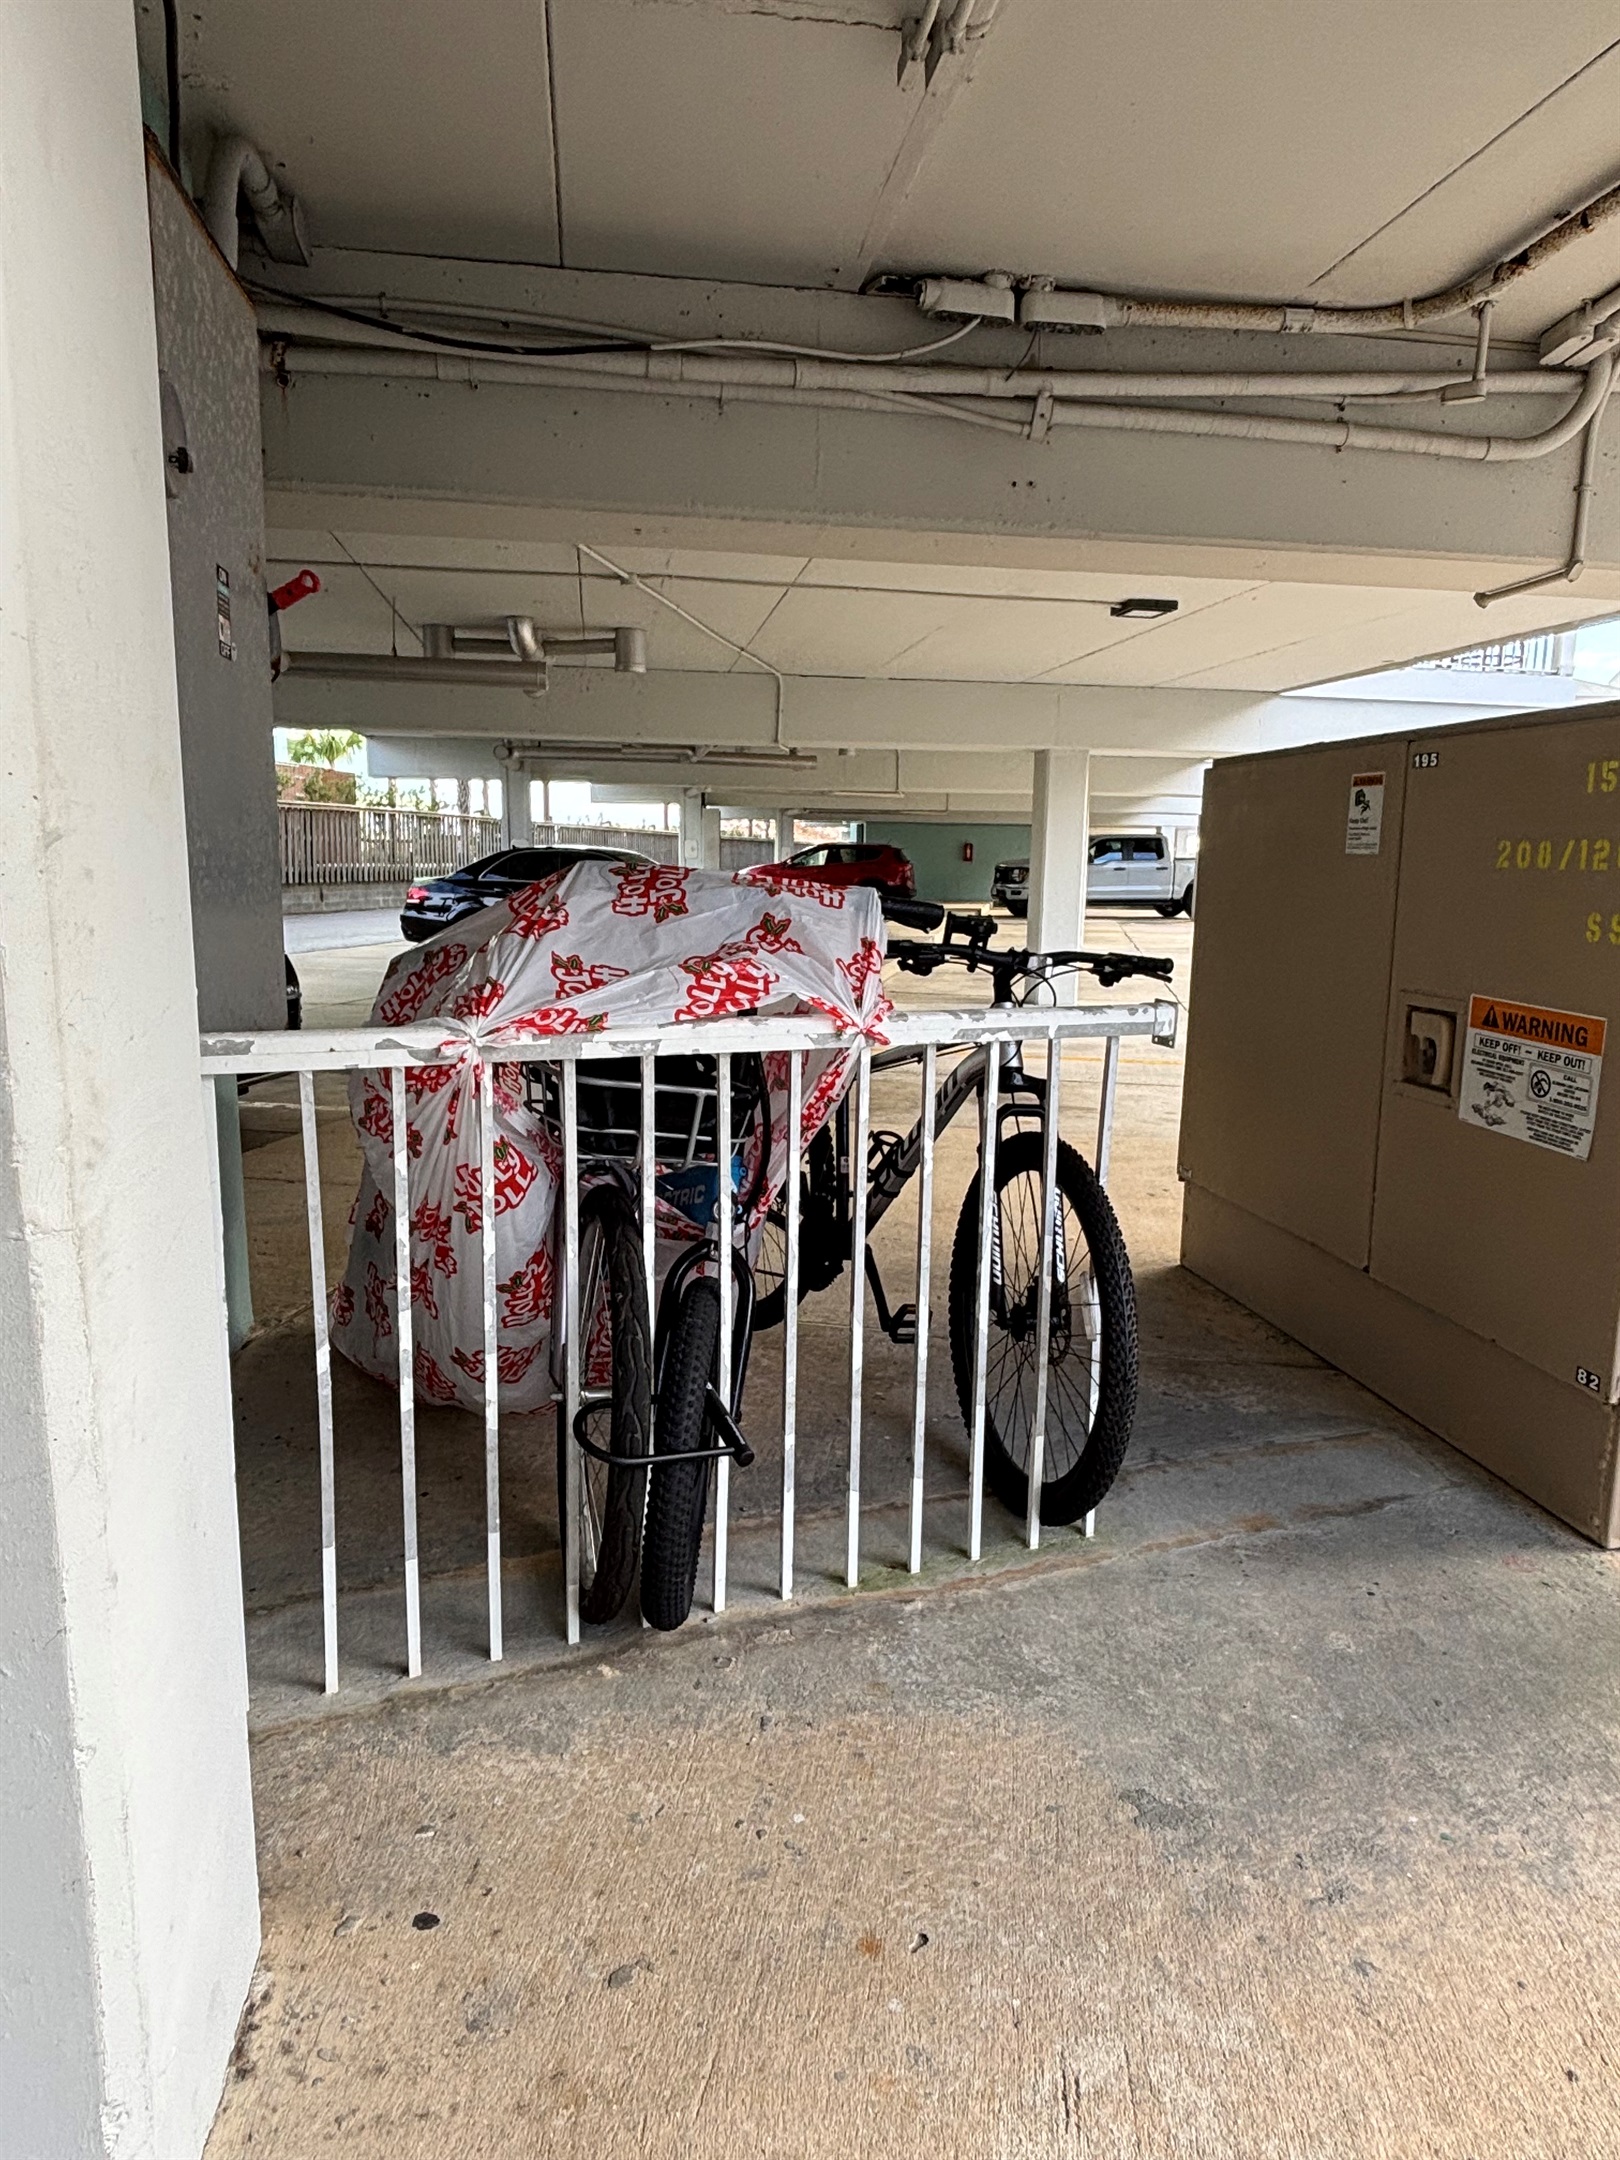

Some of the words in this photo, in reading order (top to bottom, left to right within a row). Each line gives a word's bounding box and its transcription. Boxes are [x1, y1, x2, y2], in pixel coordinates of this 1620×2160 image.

[1413, 753, 1438, 768] 195
[1496, 838, 1620, 871] 208/12
[1502, 1011, 1589, 1047] WARNING
[1479, 1036, 1500, 1050] KEEP
[1502, 1041, 1522, 1055] OFF!
[1537, 1050, 1562, 1064] KEEP
[1563, 1056, 1586, 1071] OUT!
[1577, 1368, 1599, 1391] 82
